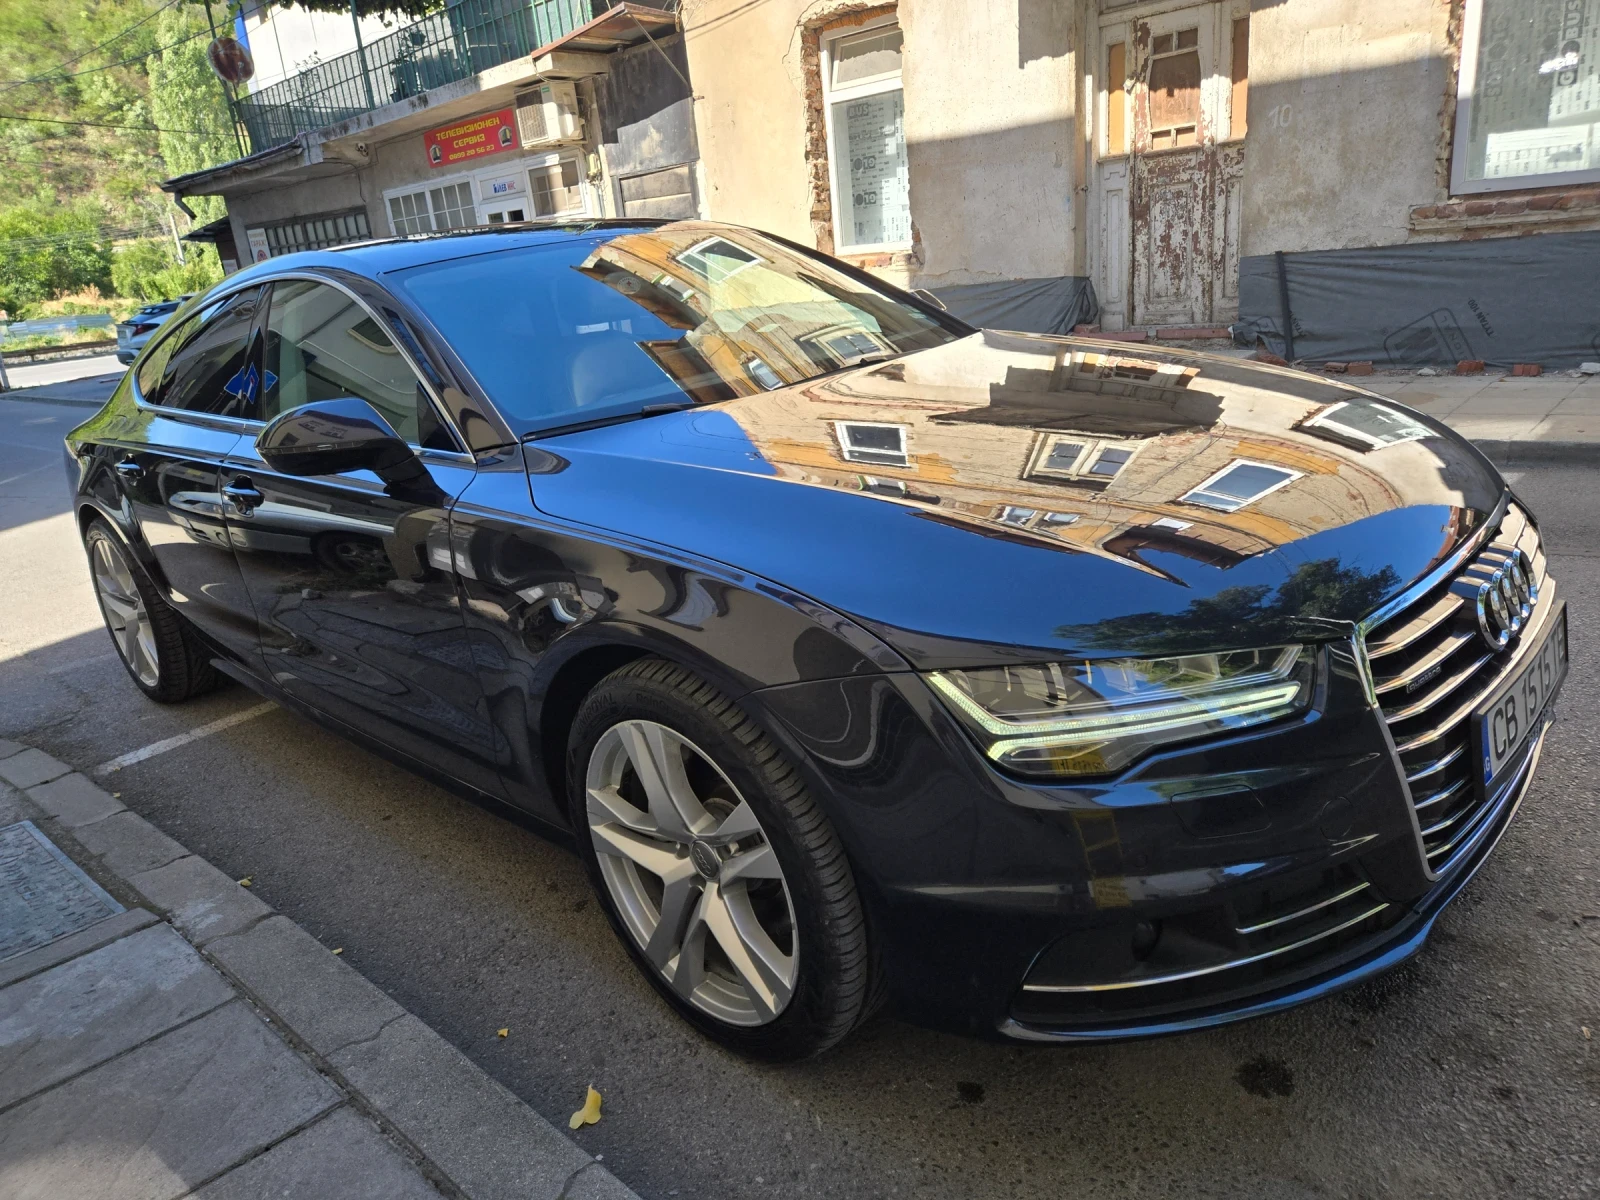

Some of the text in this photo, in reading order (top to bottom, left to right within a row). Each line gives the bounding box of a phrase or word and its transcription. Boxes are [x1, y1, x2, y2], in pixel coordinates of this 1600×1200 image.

[436, 117, 500, 140] ТЕЛЕВИЗИОНЕН
[1268, 104, 1293, 129] 10
[453, 134, 485, 148] СЕРВИЗ
[1475, 311, 1494, 337] TYTAN
[1409, 666, 1441, 690] quattro
[1493, 694, 1518, 761] CB
[1522, 643, 1551, 725] 1515
